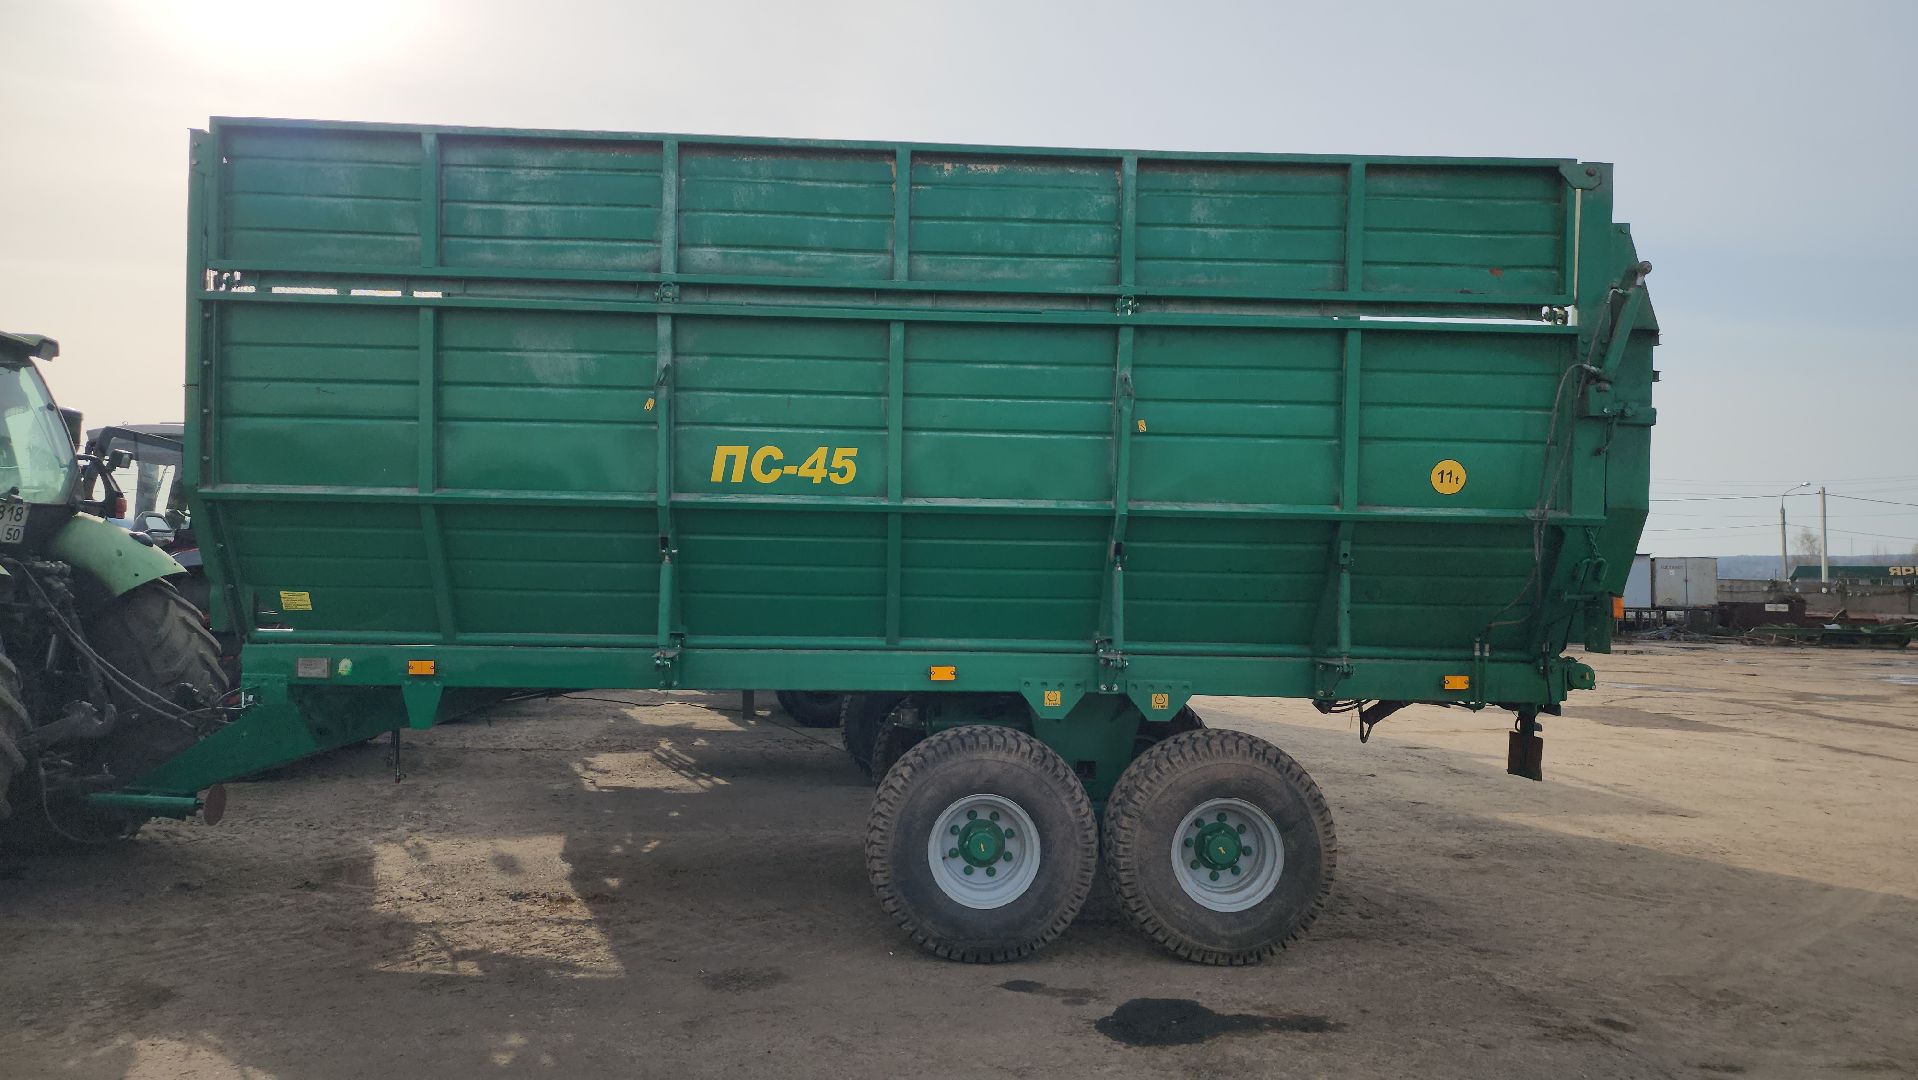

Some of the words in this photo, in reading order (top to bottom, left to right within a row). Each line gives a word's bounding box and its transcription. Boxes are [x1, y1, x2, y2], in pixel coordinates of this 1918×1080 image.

[710, 445, 858, 485] ПС-45
[5, 527, 21, 541] 50
[1888, 566, 1918, 576] ЯР
